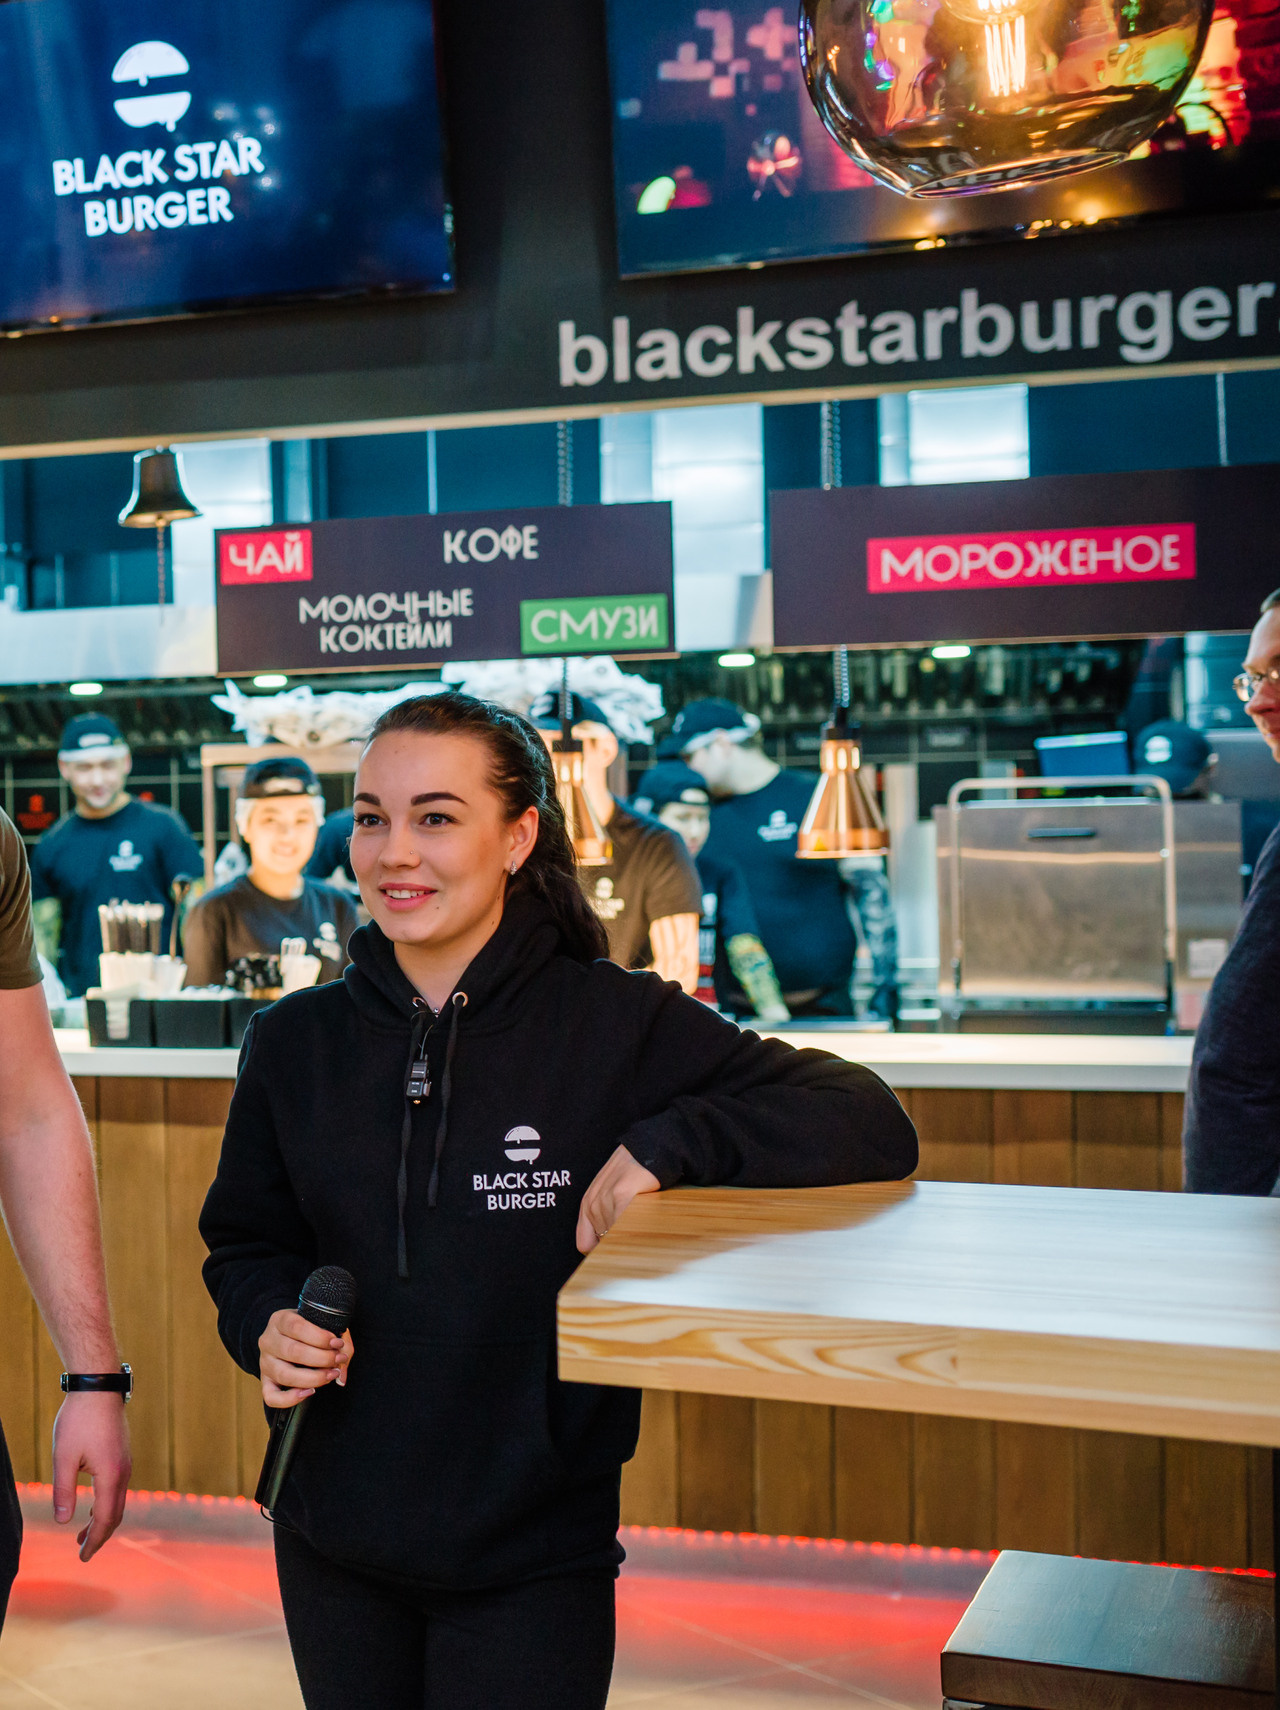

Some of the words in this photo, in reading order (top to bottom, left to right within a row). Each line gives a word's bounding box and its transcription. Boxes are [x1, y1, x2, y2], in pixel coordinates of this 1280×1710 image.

[52, 148, 169, 196] BLACK
[174, 136, 265, 183] STAR
[84, 186, 235, 237] BURGER
[228, 532, 304, 577] ЧАЙ
[443, 524, 539, 564] КОФЕ
[880, 534, 1181, 584] МОРОЖЕНОЕ
[298, 587, 474, 624] МОЛОЧНЫЕ
[319, 614, 452, 654] КОКТЕЙЛИ
[530, 604, 660, 643] СМУЗИ
[473, 1172, 529, 1191] BLACK
[532, 1170, 571, 1188] STAR
[487, 1192, 556, 1210] BURGER
